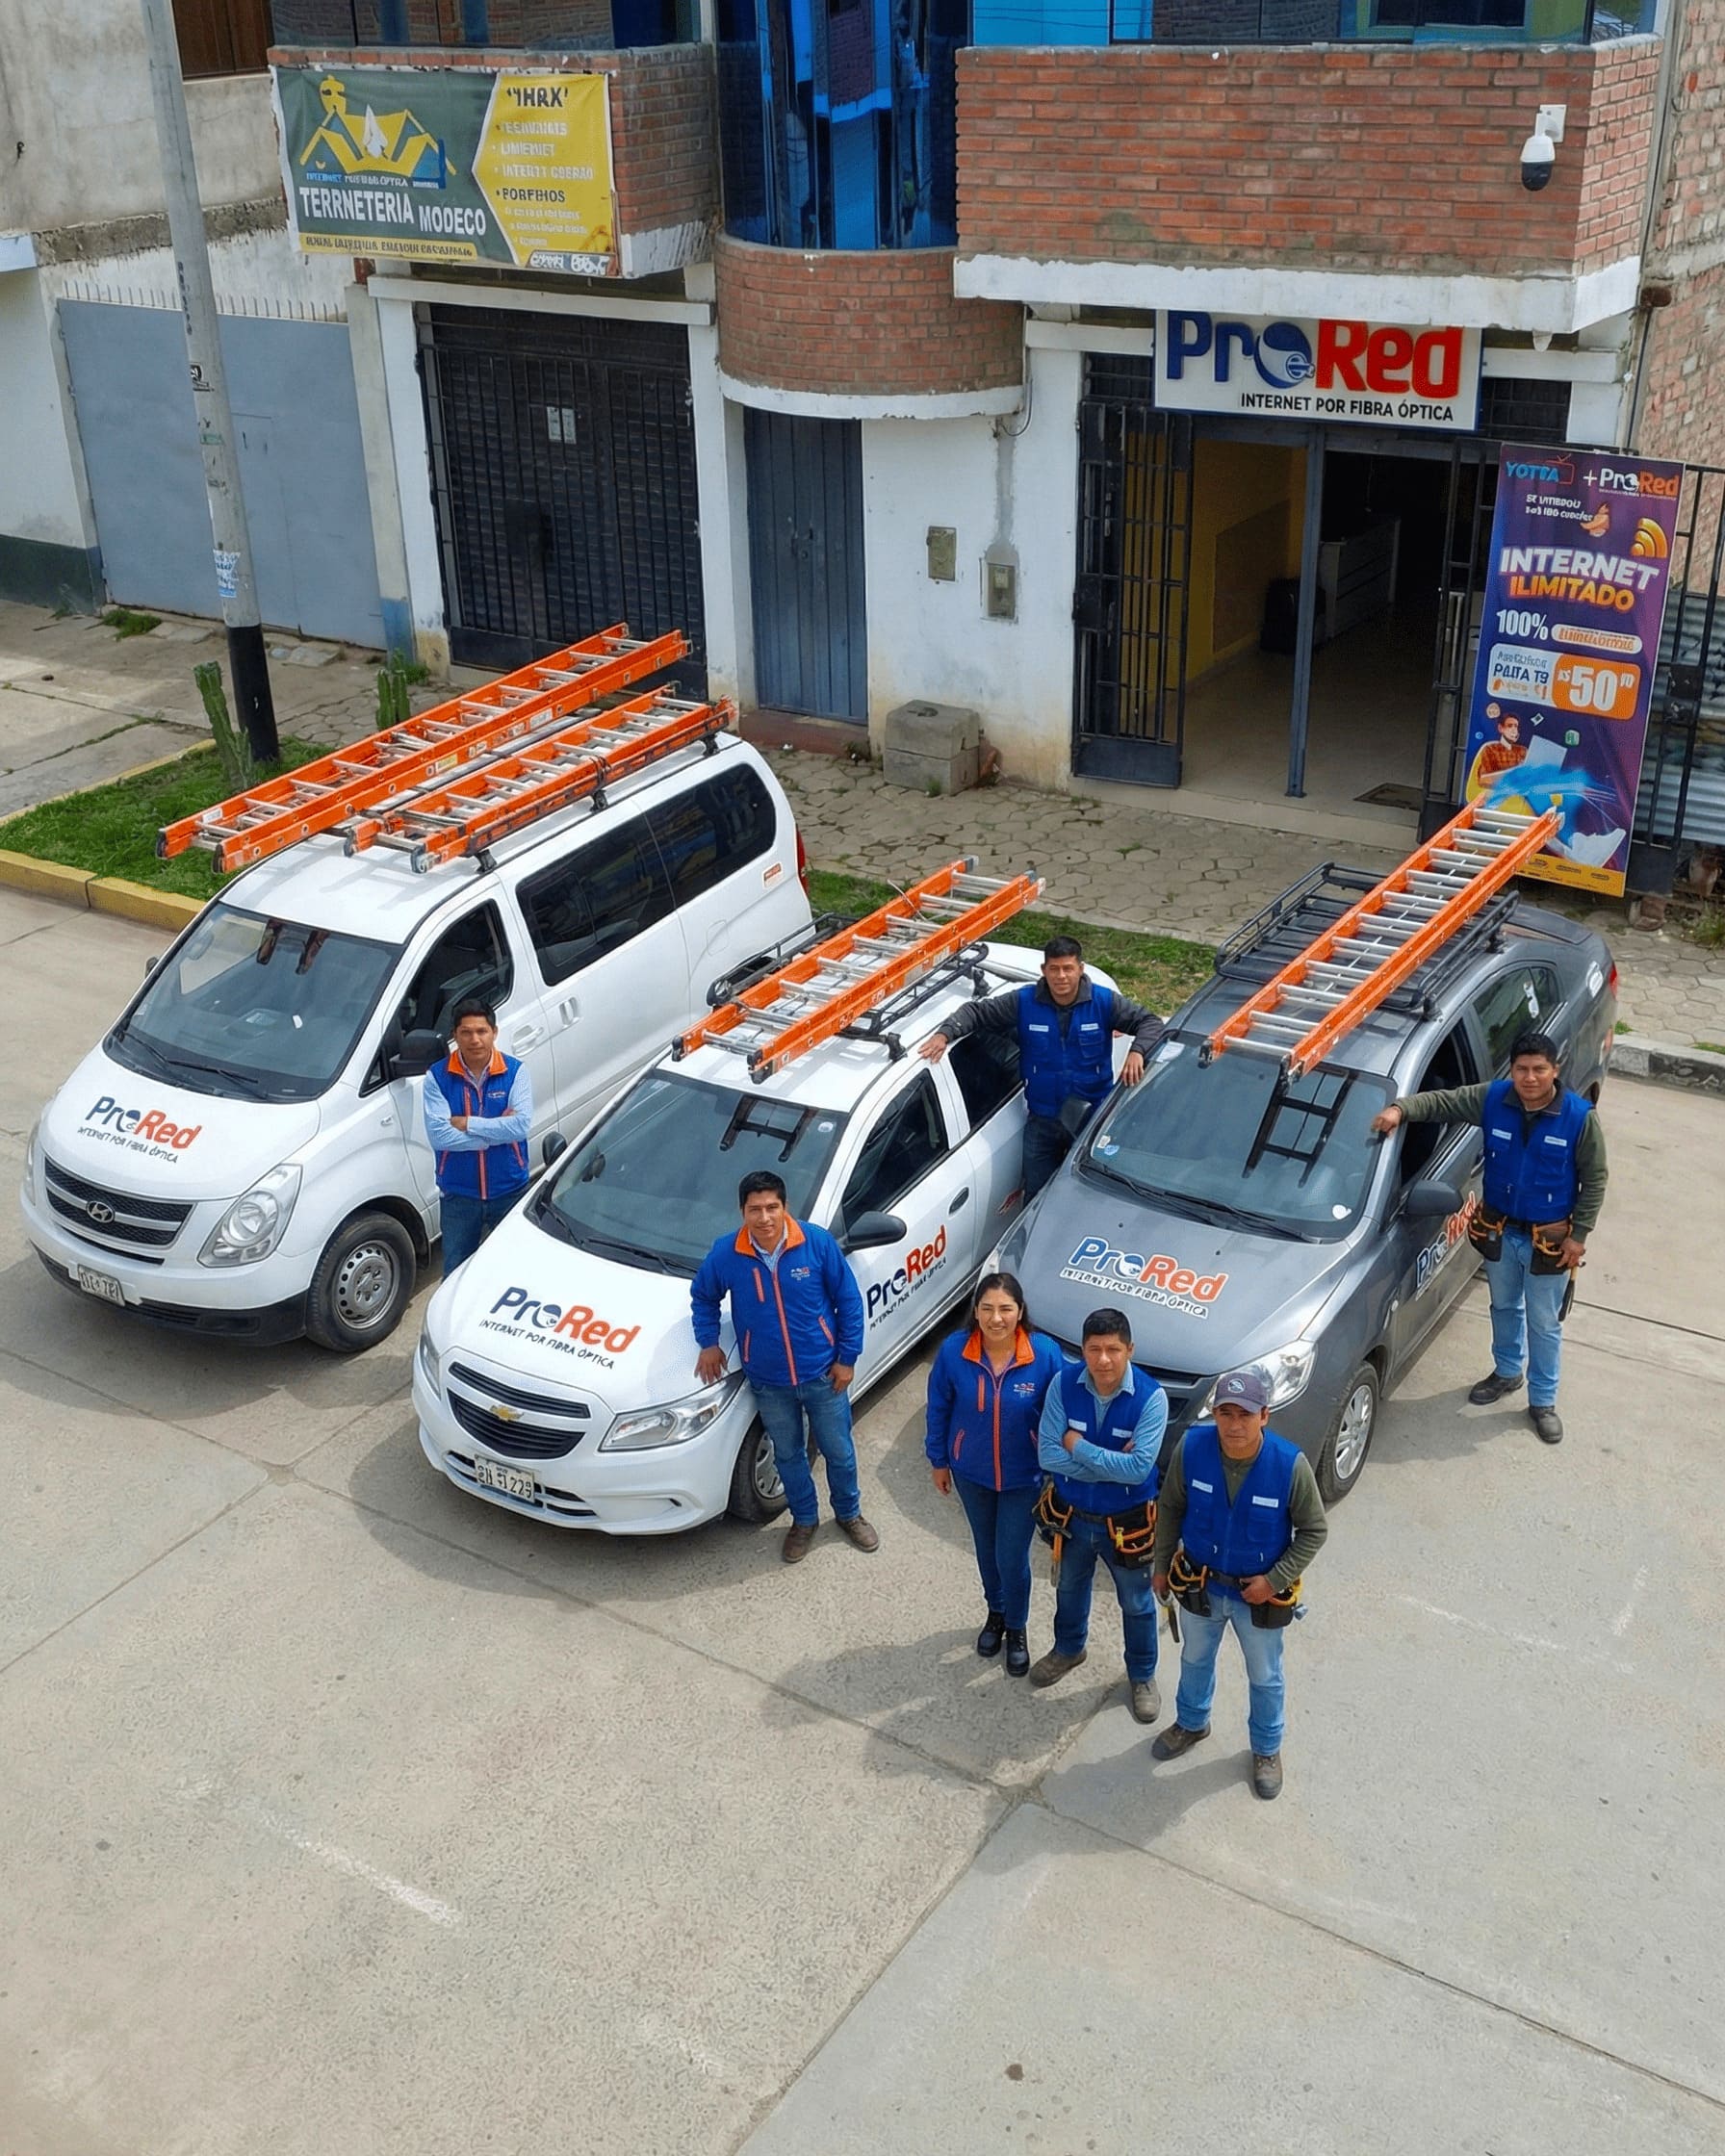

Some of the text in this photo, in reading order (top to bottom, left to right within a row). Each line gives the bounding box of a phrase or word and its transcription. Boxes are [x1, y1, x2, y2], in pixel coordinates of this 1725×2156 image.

[299, 186, 486, 236] TERRNETERIA MODECO
[1167, 309, 1465, 399] ProRed
[1241, 393, 1454, 422] INTERNET POR FIBRA ÓPTICA
[1499, 548, 1660, 590] INTERNET
[1508, 575, 1635, 612] ILIMITADO
[1496, 609, 1549, 641] 100%
[85, 1095, 202, 1149] ProRed
[866, 1223, 947, 1319] ProRed
[1068, 1236, 1229, 1302] ProRed
[489, 1286, 642, 1353] ProRed
